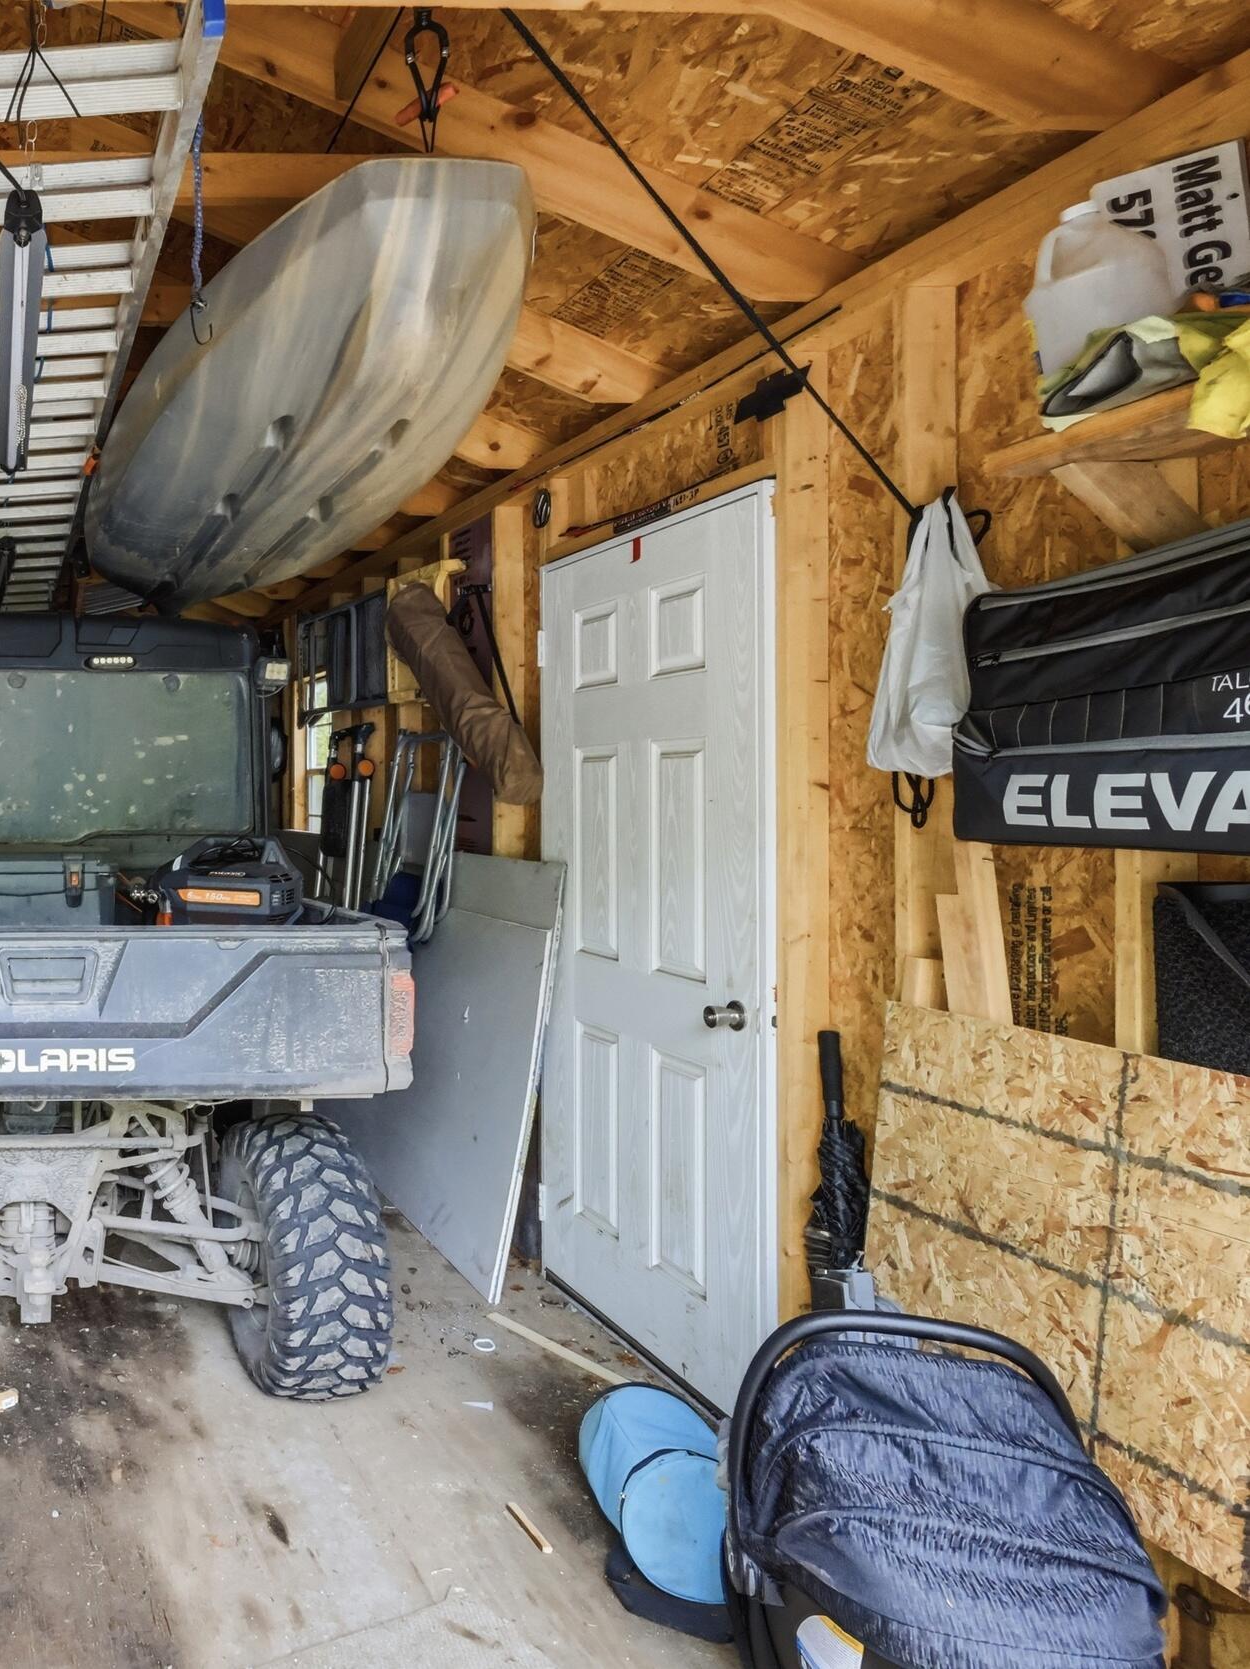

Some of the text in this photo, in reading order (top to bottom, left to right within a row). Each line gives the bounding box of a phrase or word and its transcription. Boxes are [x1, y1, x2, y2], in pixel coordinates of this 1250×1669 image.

[1172, 155, 1232, 287] Matt Ge
[1212, 672, 1250, 691] TAL
[1003, 770, 1250, 832] ELEVA
[1025, 925, 1036, 941] and
